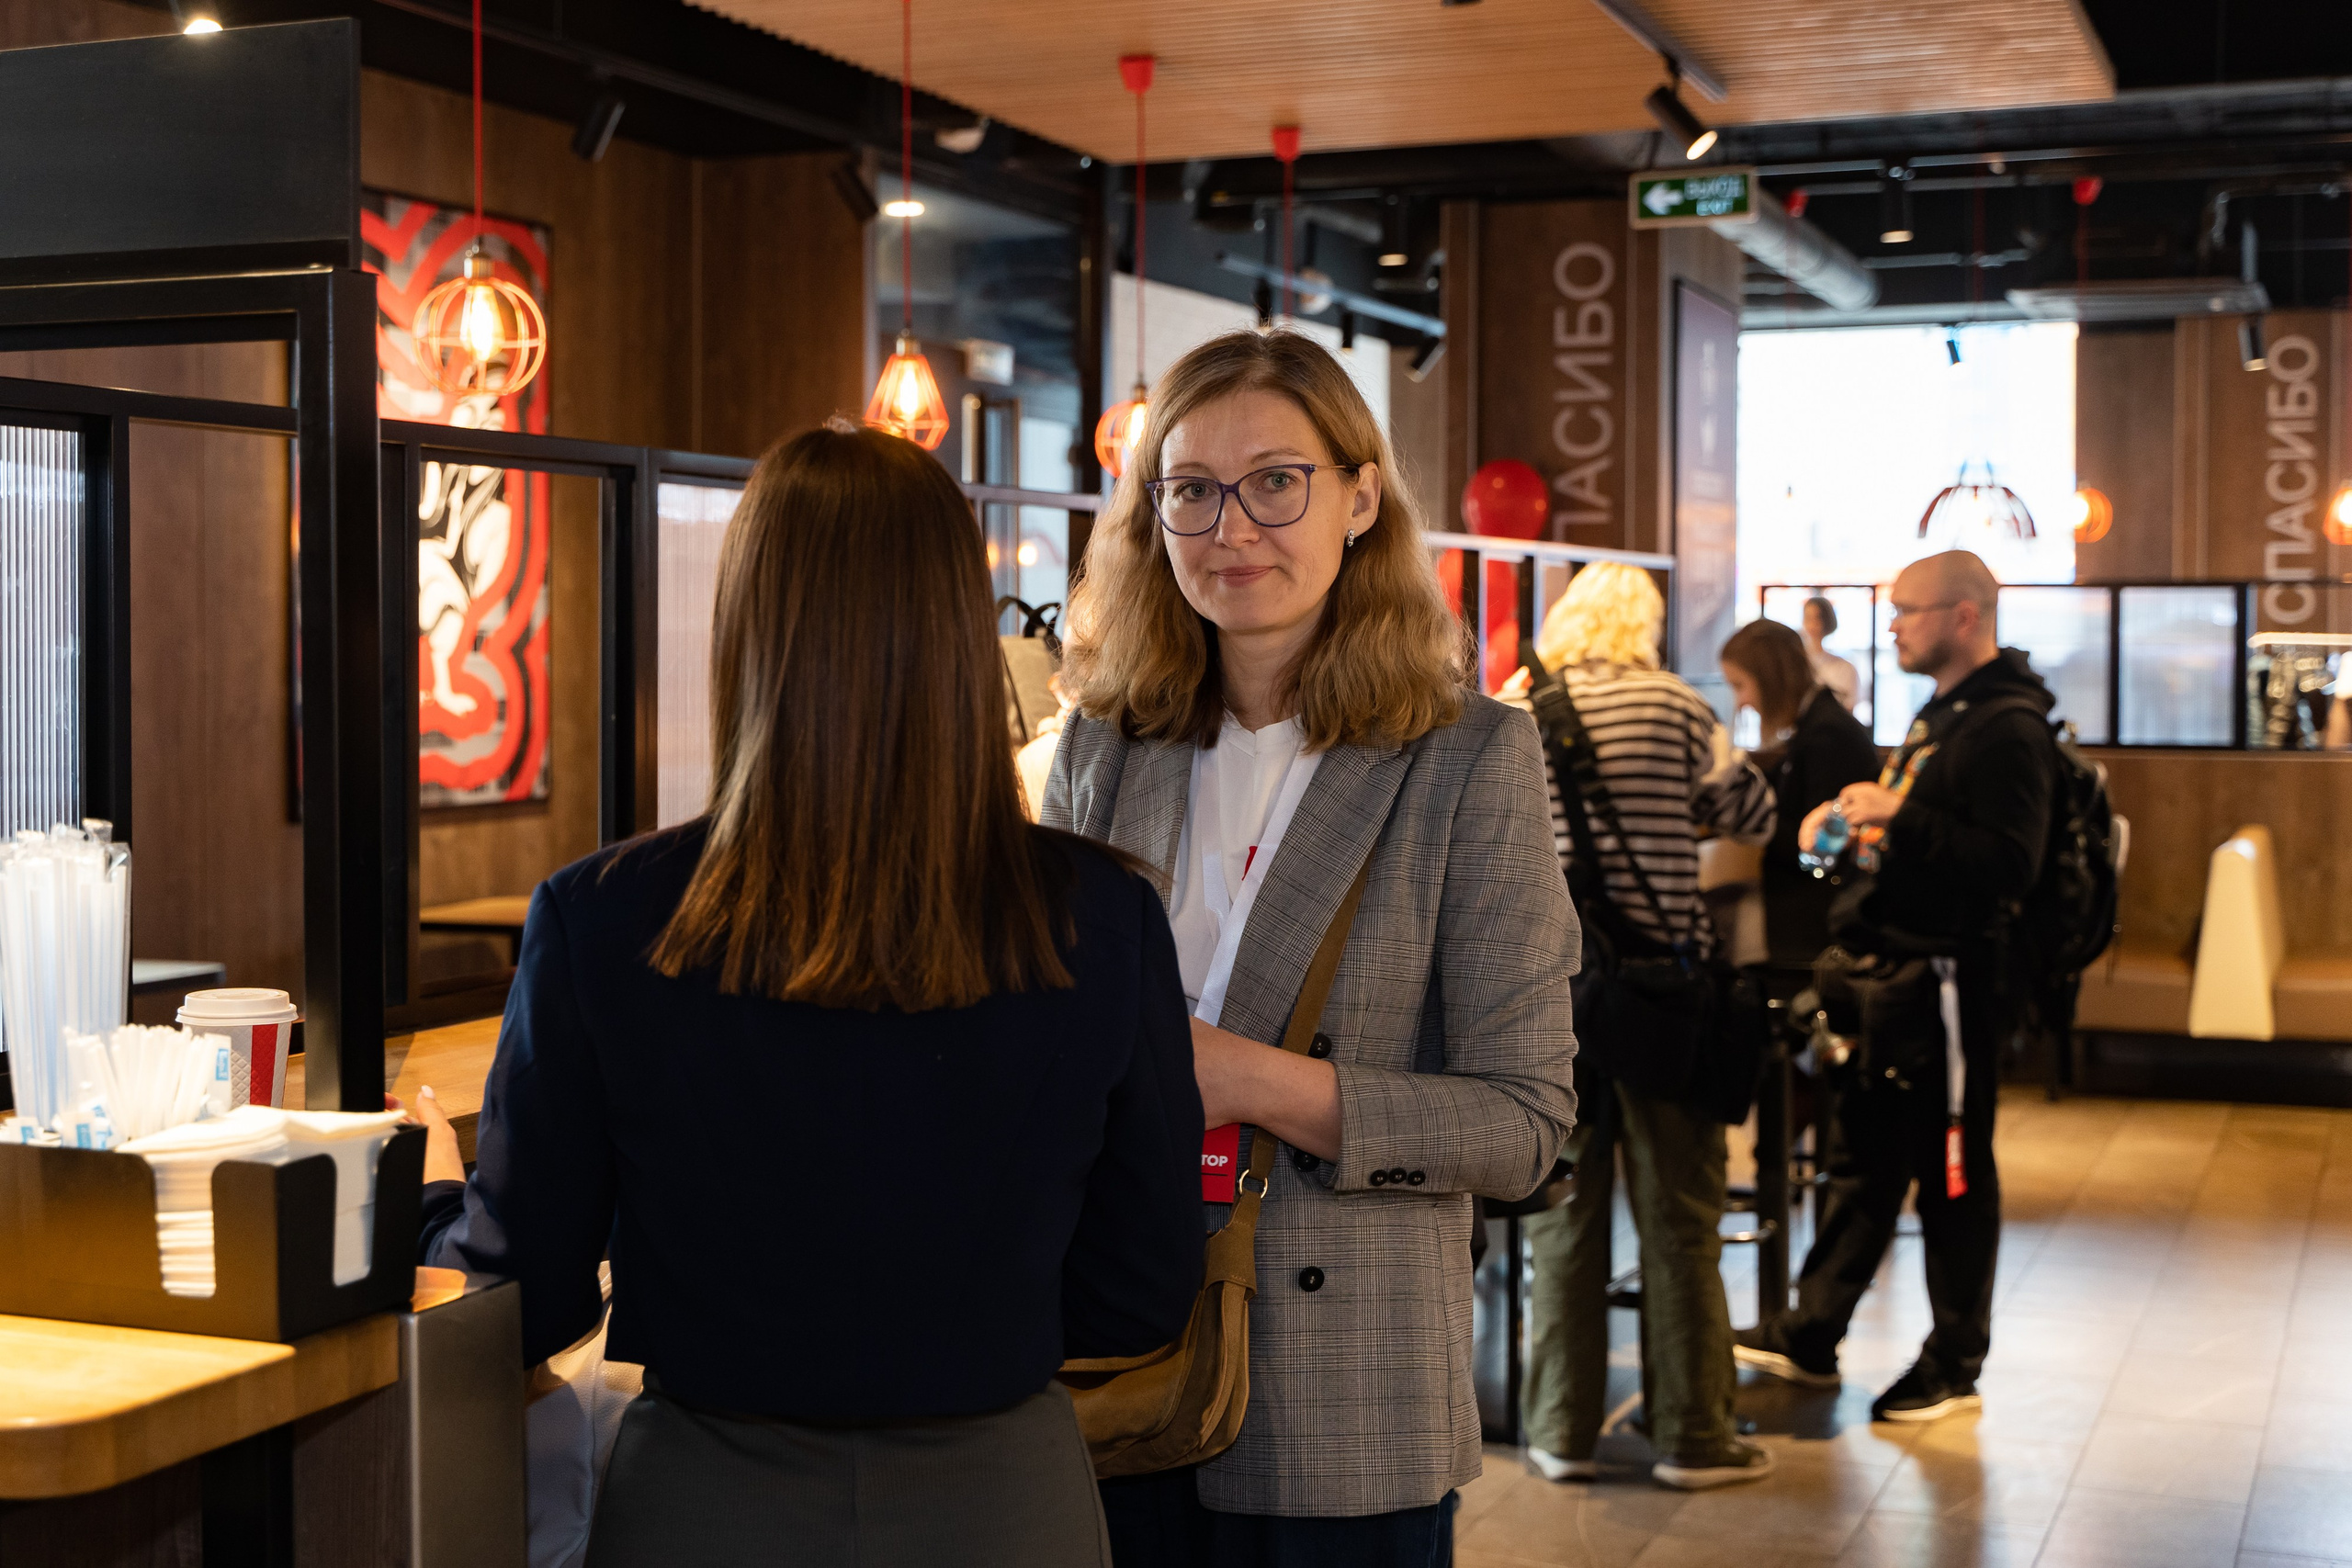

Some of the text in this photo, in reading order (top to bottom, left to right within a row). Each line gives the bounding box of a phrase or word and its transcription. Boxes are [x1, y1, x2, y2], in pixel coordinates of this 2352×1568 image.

[1553, 242, 1615, 543] ПАСИБО
[2264, 334, 2321, 626] СПАСИБО
[1201, 1154, 1229, 1168] ТОР
